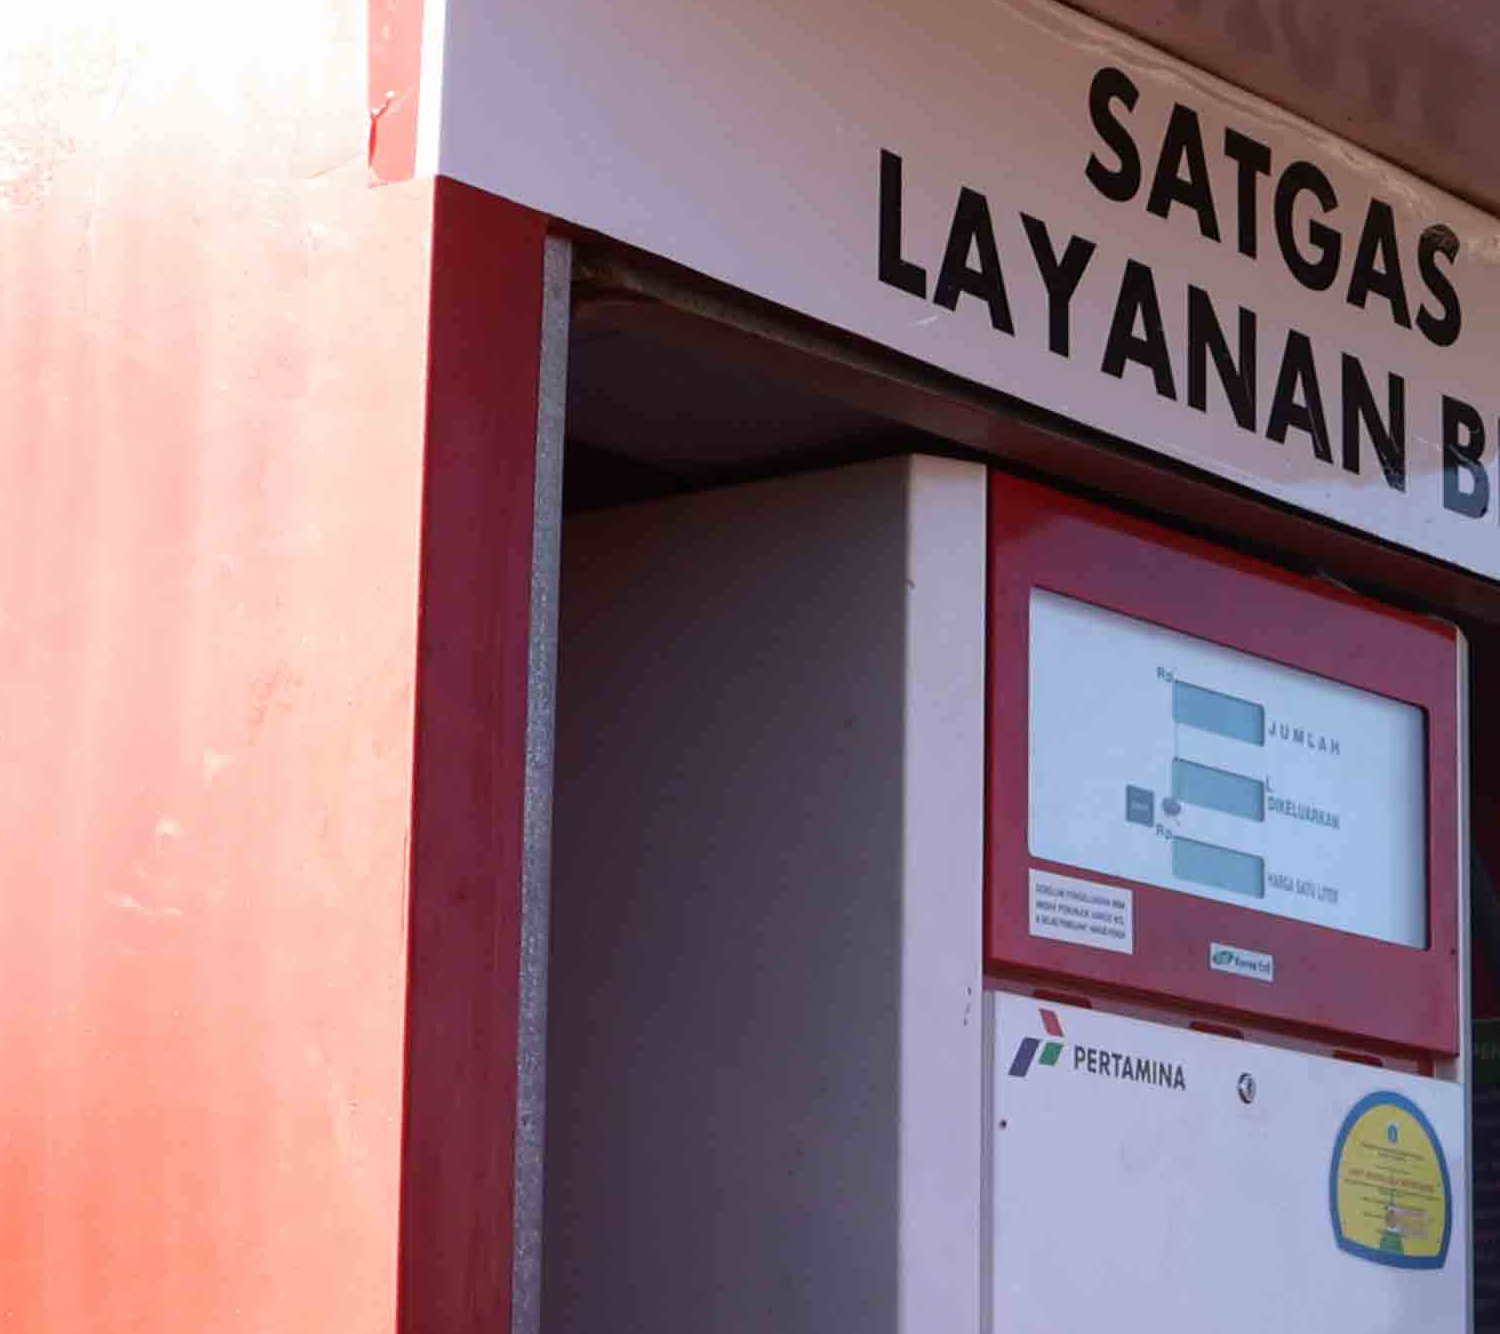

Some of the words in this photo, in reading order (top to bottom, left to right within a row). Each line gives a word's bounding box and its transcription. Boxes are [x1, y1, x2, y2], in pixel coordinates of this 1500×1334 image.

[1084, 67, 1463, 348] SATGAS
[879, 148, 1407, 494] LAYANAN
[1268, 720, 1341, 756] JUMLAH
[1073, 1045, 1187, 1091] PERTAMINA
